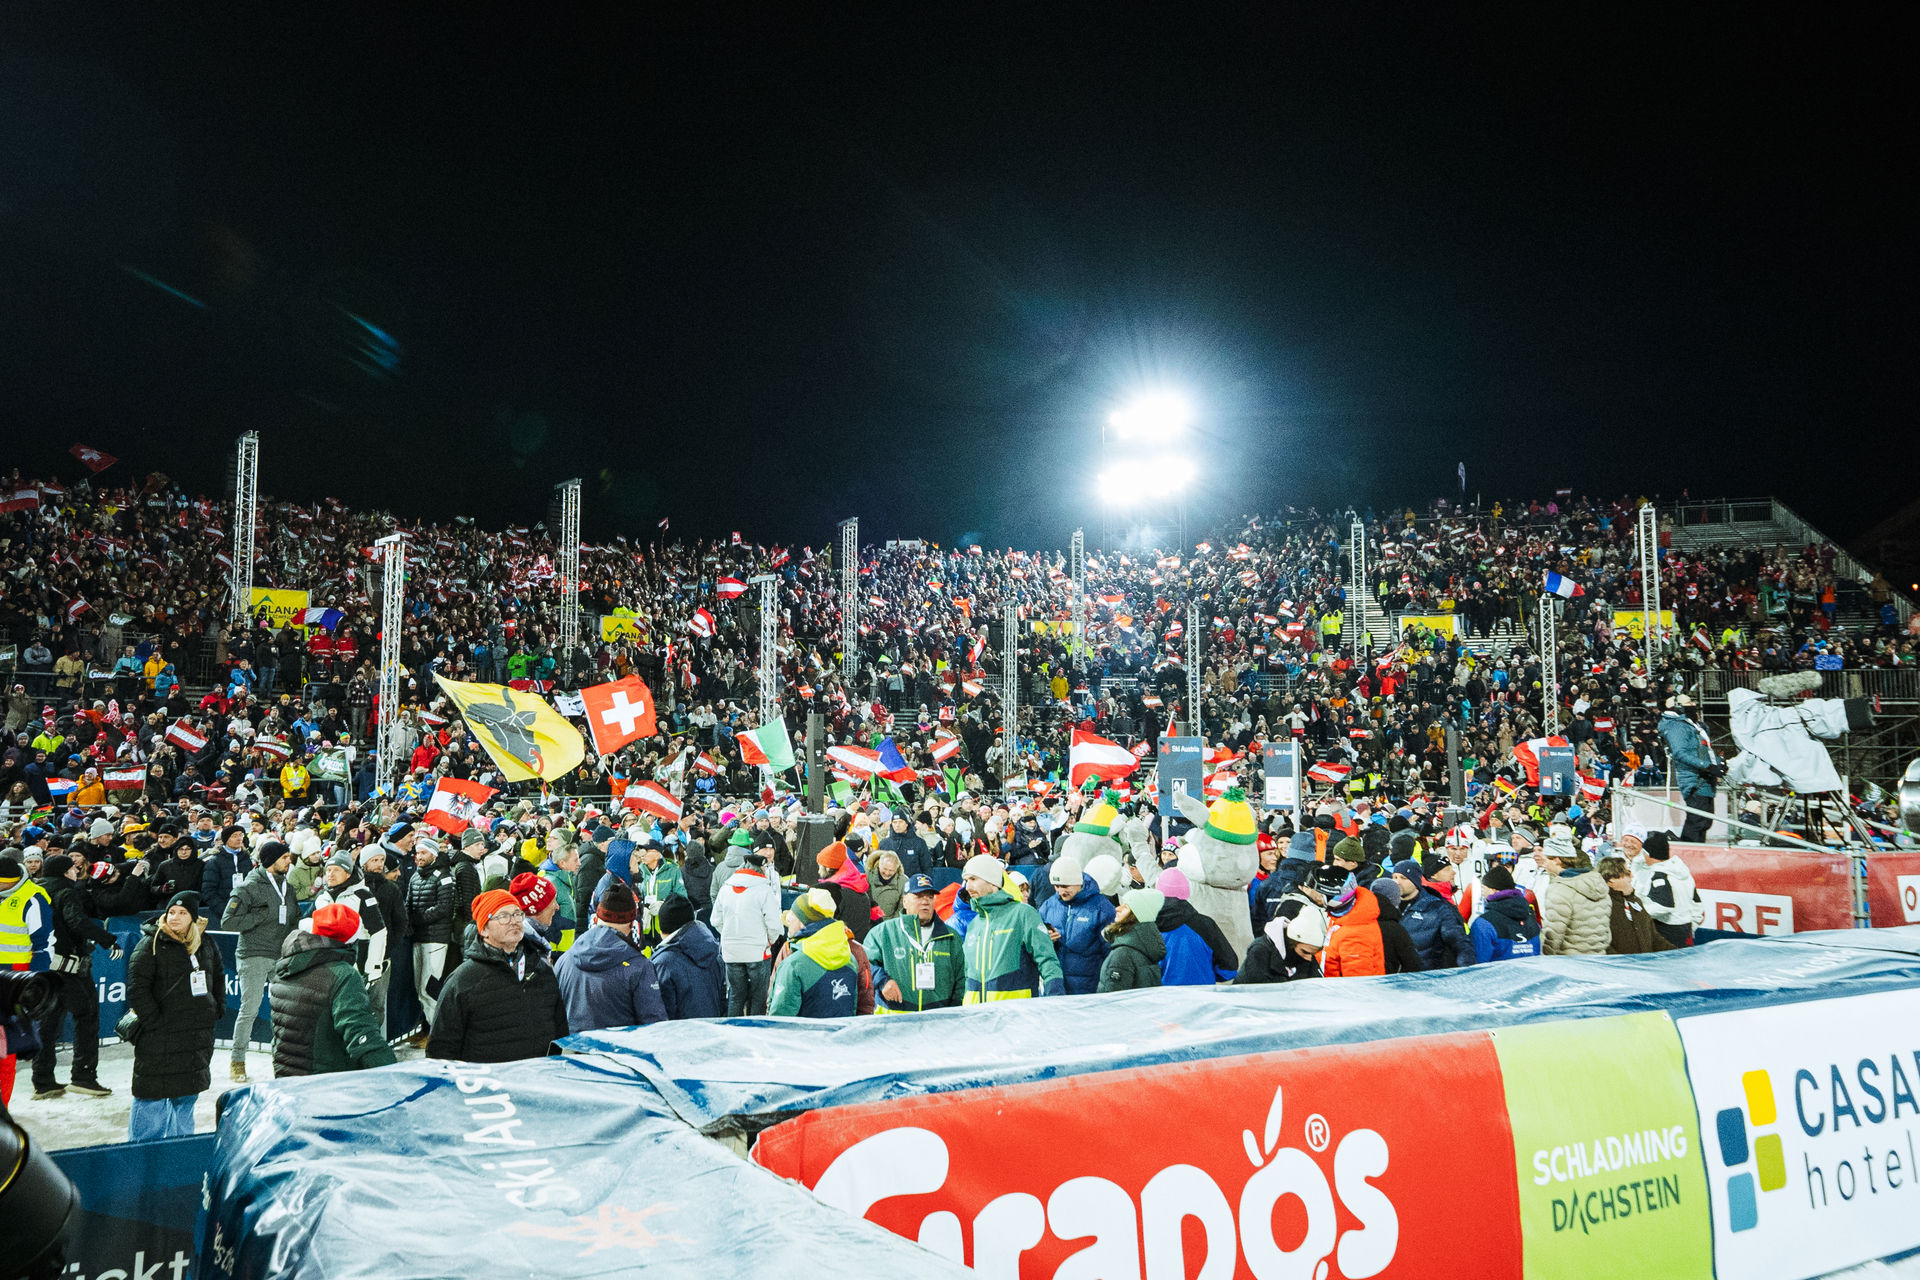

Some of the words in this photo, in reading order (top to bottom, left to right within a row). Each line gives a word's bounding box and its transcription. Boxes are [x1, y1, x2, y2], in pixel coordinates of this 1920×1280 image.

[522, 878, 547, 905] ROCK
[1701, 902, 1781, 935] RF
[96, 976, 127, 1003] ia
[1533, 1125, 1688, 1186] SCHLADMING
[1804, 1130, 1918, 1209] hotel
[1551, 1173, 1681, 1236] DACHSTEIN
[62, 1250, 191, 1280] kt
